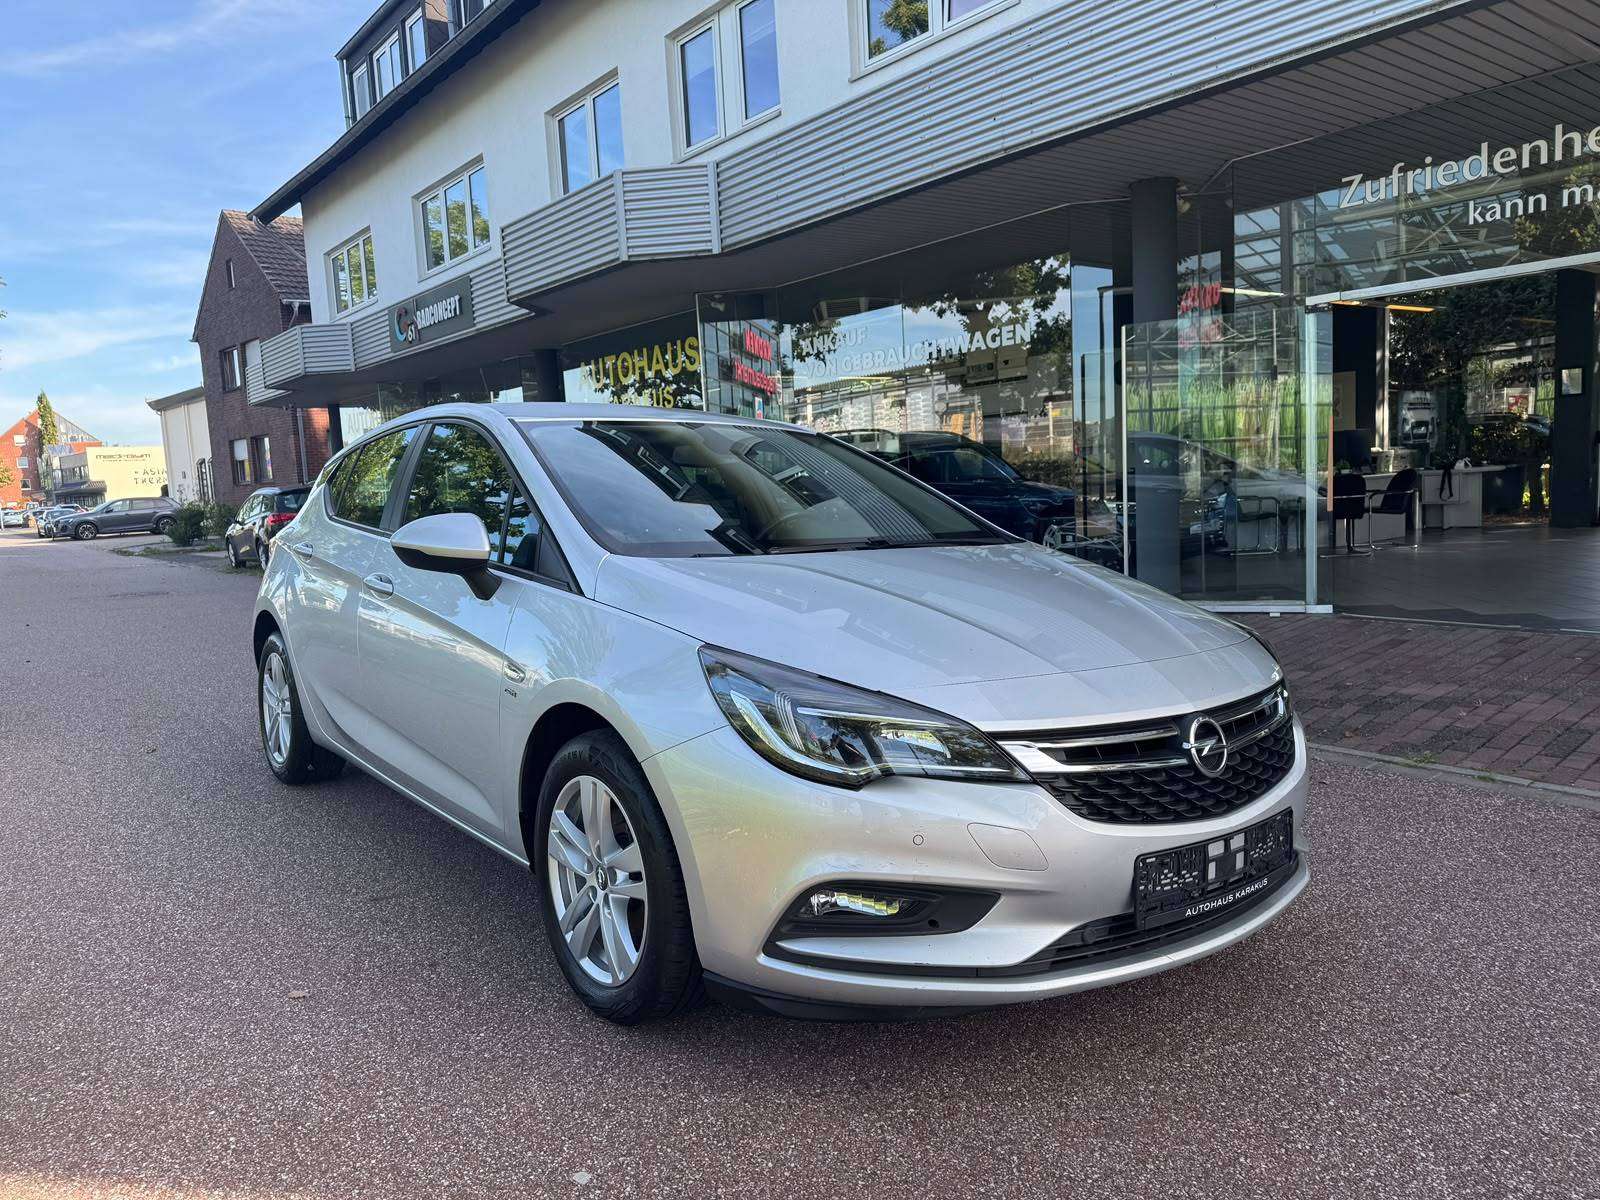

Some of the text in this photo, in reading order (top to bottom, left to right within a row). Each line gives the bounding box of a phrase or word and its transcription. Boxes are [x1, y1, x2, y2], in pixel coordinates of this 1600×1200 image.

[1468, 184, 1600, 225] kann m
[416, 295, 461, 330] BADCONCEPT
[802, 327, 868, 355] ANKAUF
[804, 362, 838, 378] VON
[843, 321, 1032, 373] GEBRAUCHTWAGEN
[580, 337, 699, 389] AUTOHAUS
[1185, 878, 1268, 917] AUTOHAUS KARAKUS
